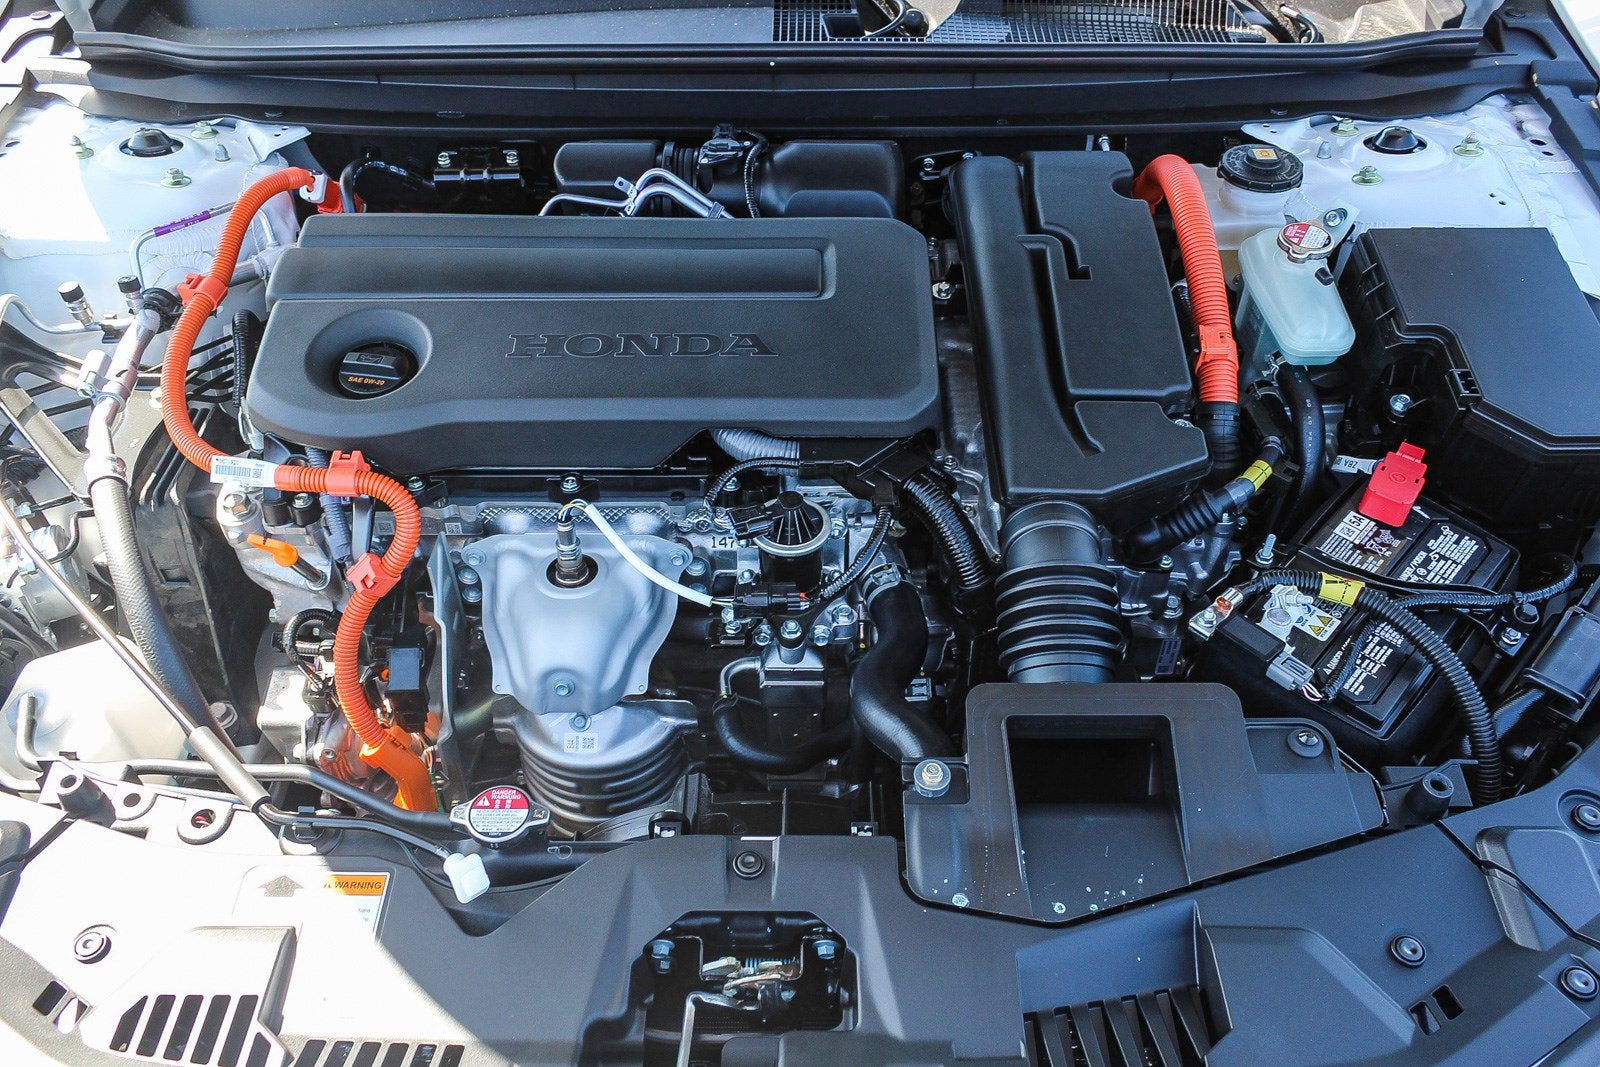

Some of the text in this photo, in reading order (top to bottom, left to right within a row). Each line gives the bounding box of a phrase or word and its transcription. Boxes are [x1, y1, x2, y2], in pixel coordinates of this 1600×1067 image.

[505, 333, 779, 358] HONDA
[363, 378, 386, 386] 0W-20
[1350, 515, 1366, 527] 5A
[711, 536, 735, 548] 147
[335, 881, 382, 889] WARNING
